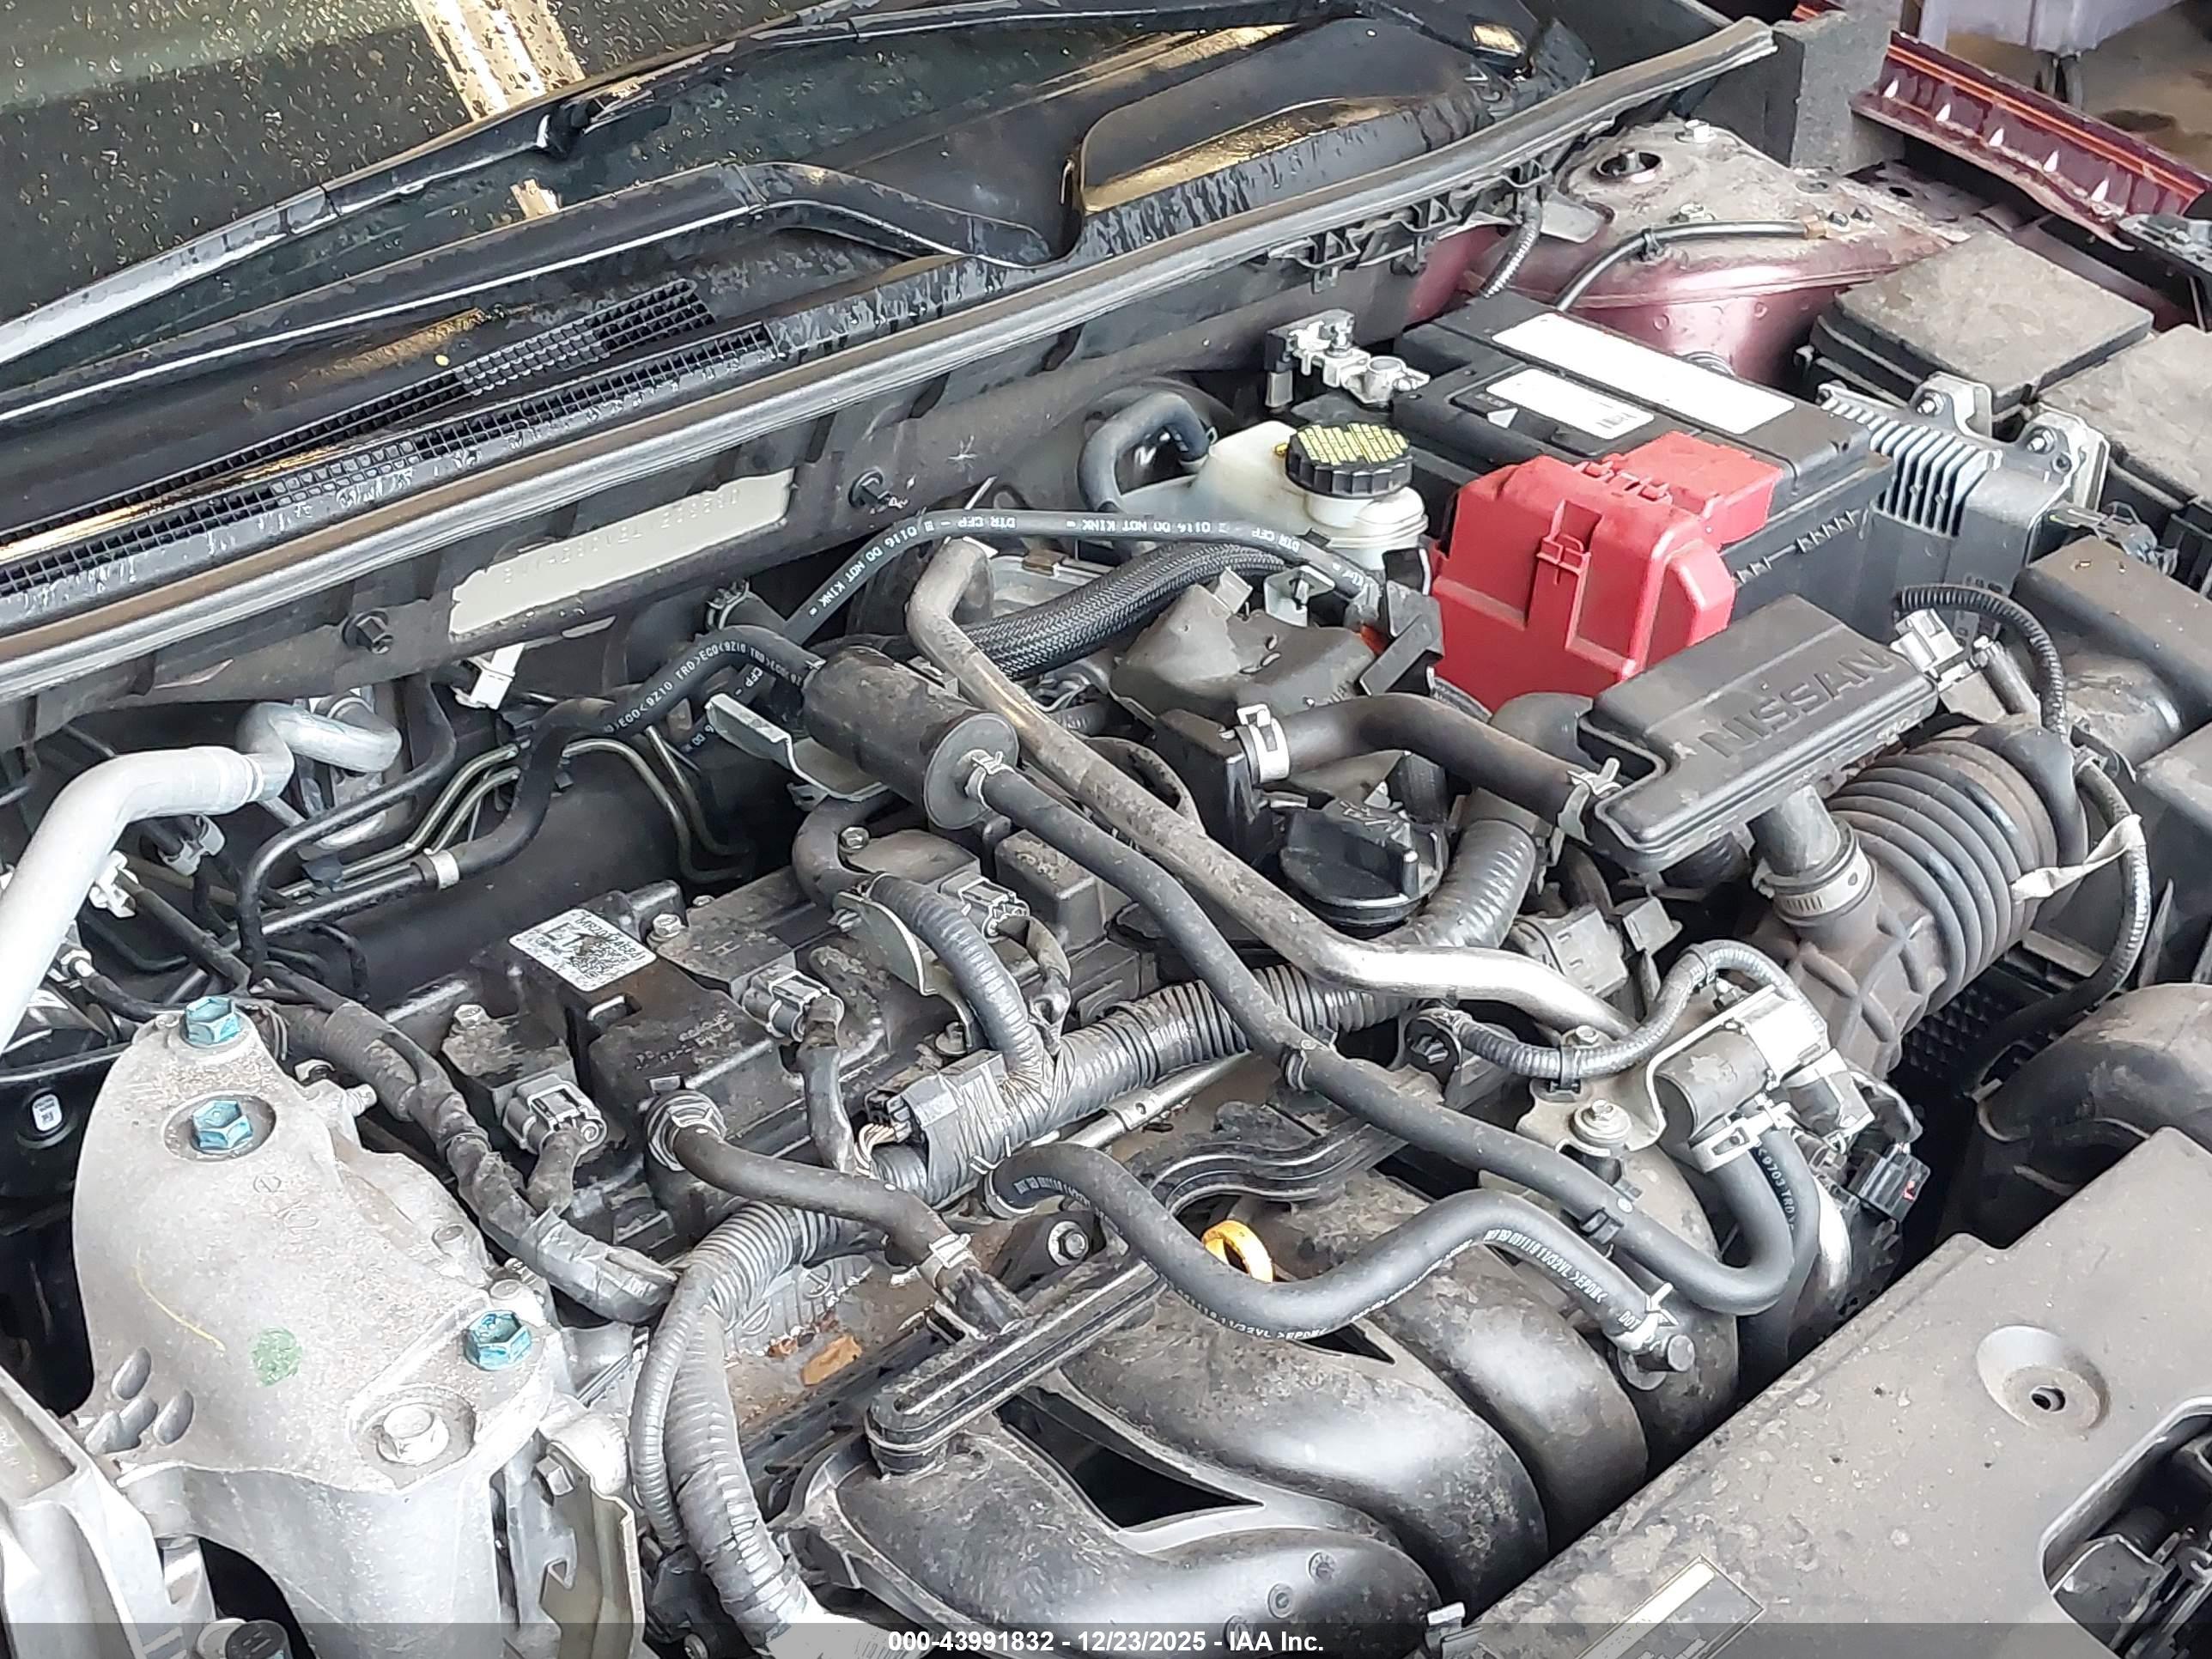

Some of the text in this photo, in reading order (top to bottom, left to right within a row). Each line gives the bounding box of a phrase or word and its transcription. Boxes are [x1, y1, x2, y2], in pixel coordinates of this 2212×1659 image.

[1082, 519, 1115, 531] KINK
[1121, 520, 1147, 532] NOT
[1153, 520, 1170, 532] DO
[865, 546, 884, 562] DO
[844, 560, 866, 582] NOT
[817, 580, 846, 608] KINK
[744, 666, 763, 688] CFP
[1698, 648, 1896, 758] NISSAN
[1618, 1310, 1643, 1330] DOT
